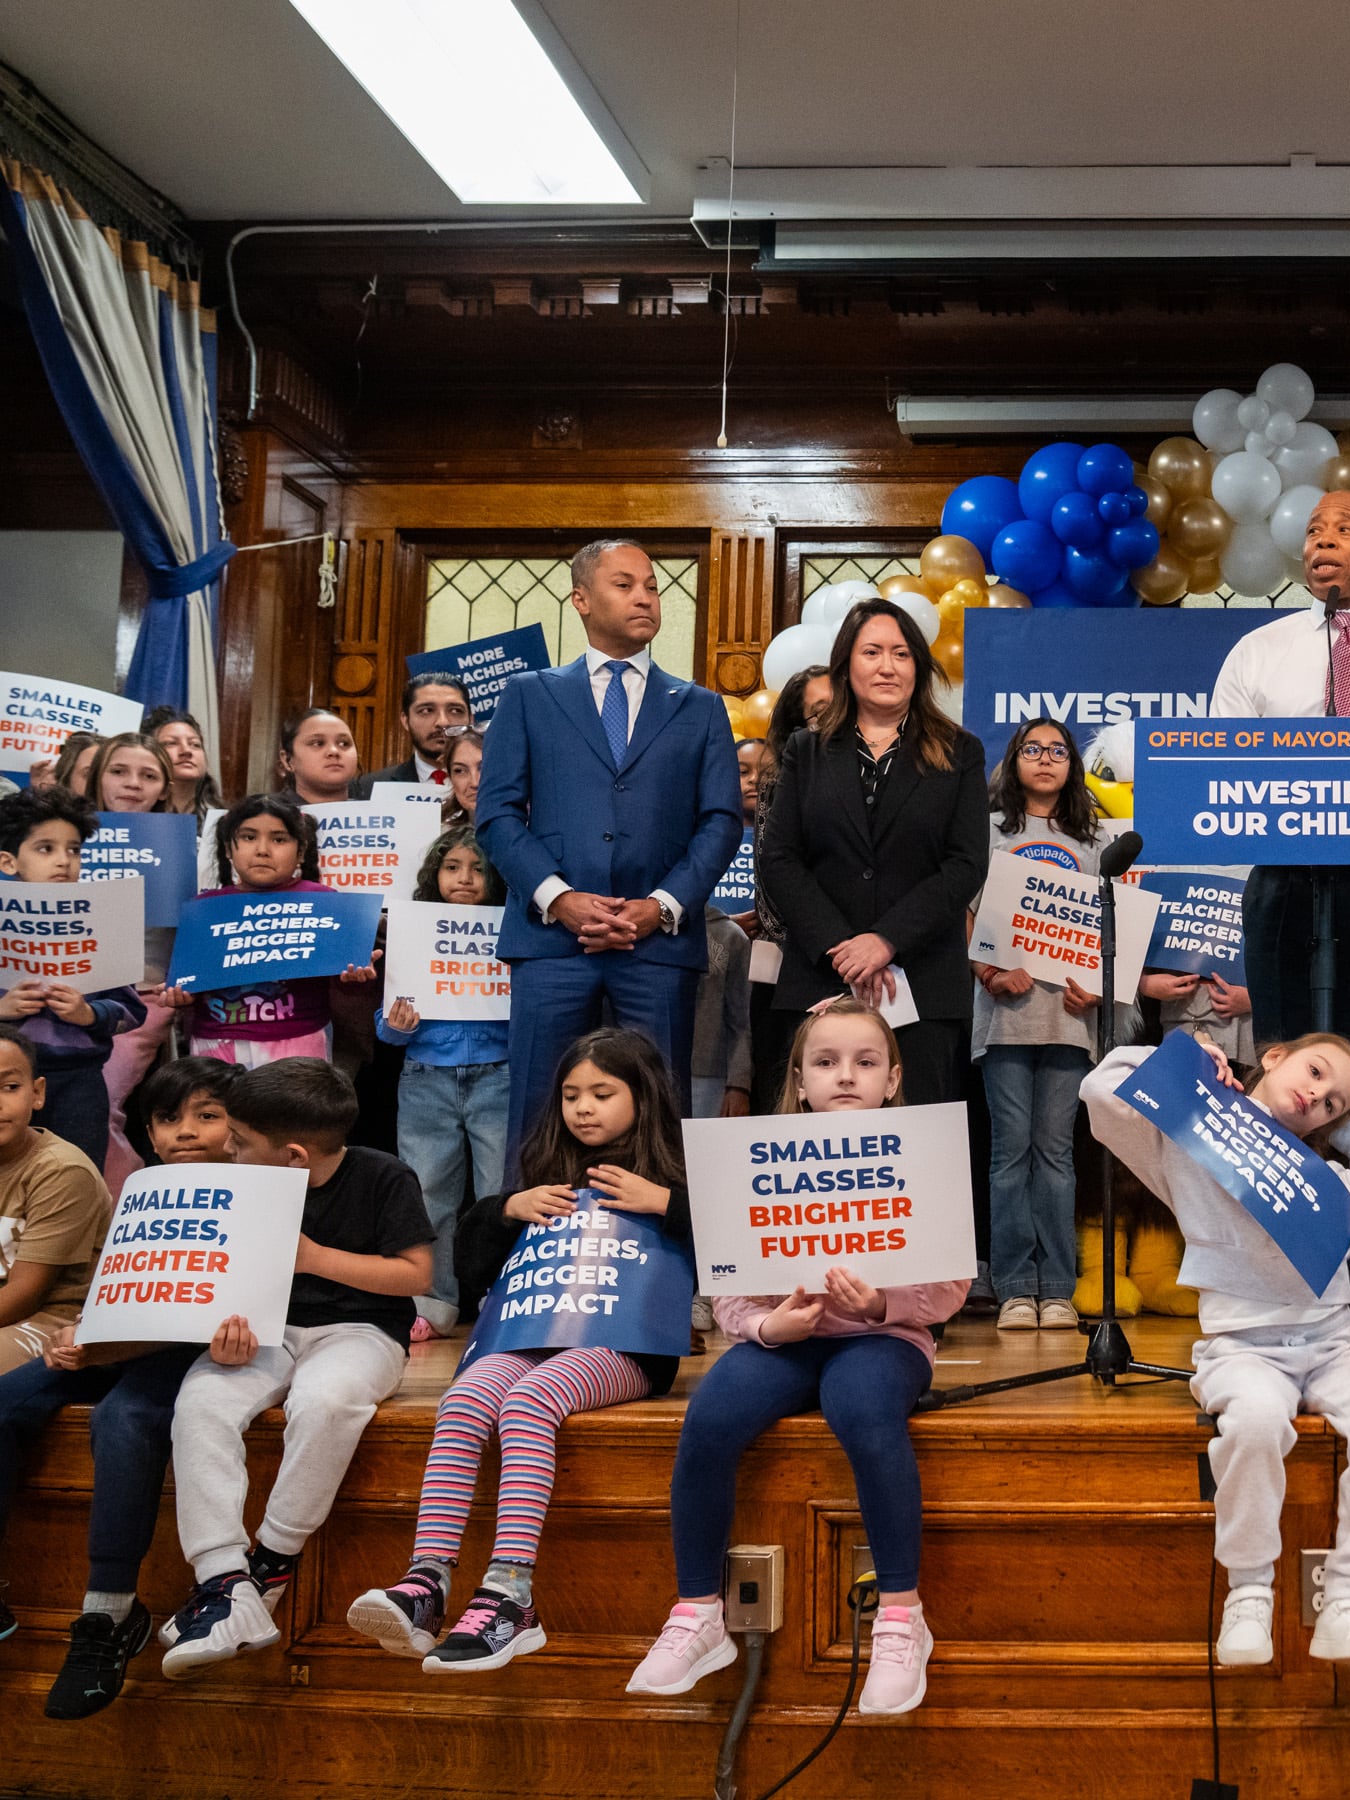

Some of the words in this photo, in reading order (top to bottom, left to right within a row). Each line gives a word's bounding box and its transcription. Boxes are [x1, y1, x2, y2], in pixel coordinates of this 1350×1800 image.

[457, 646, 506, 669] MORE
[463, 657, 528, 684] ACHERS,
[468, 677, 509, 699] IGGE
[9, 687, 103, 716] SMALLER
[994, 692, 1207, 724] INVESTIN
[0, 720, 73, 739] BRIGHT
[6, 704, 100, 732] CLASSES,
[2, 737, 61, 755] FUTU
[1149, 731, 1227, 748] OFFICE
[1235, 731, 1265, 747] OF
[85, 828, 130, 843] ORE
[316, 816, 396, 831] MALLER
[1193, 811, 1267, 836] OUR
[319, 834, 396, 850] ASSES,
[81, 848, 161, 866] CHERS,
[319, 853, 399, 867] IGHTER
[80, 868, 140, 883] GGER
[320, 873, 393, 887] TURES
[1025, 876, 1101, 909] SMALLE
[1186, 886, 1243, 907] MORE
[0, 897, 91, 915] ALLER
[243, 902, 313, 917] MORE
[1020, 896, 1102, 930] CLASSES
[1160, 901, 1243, 926] TEACHER
[0, 918, 93, 936] ASSES,
[210, 916, 341, 937] TEACHERS,
[436, 919, 500, 936] SMAL
[1170, 918, 1243, 945] BIGGER
[0, 938, 98, 957] IGHTER
[227, 932, 316, 951] BIGGER
[435, 940, 496, 956] CLAS
[979, 941, 995, 951] NYC
[1012, 935, 1100, 970] FUTURES
[1164, 936, 1240, 962] IMPACT
[222, 947, 315, 968] IMPACT
[430, 959, 511, 977] BRIGHT
[176, 975, 196, 985] NYC
[435, 980, 511, 997] FUTUR
[1195, 1079, 1321, 1213] TEACHERS,
[1230, 1101, 1305, 1168] MORE
[749, 1134, 902, 1165] SMALLER
[1204, 1114, 1295, 1203] BIGGER
[1192, 1121, 1289, 1215] IMPACT
[751, 1166, 906, 1196] CLASSES,
[121, 1188, 233, 1216] SMALLER
[749, 1196, 913, 1228] BRIGHTER
[113, 1218, 228, 1246] CLASSES,
[526, 1210, 610, 1241] MORE
[760, 1228, 907, 1258] FUTURES
[100, 1250, 230, 1276] BRIGHTER
[500, 1238, 648, 1280] TEACHERS,
[711, 1264, 737, 1274] NYC
[507, 1265, 619, 1295] BIGGER
[95, 1281, 215, 1306] FUTURES
[500, 1293, 619, 1322] IMPACT
